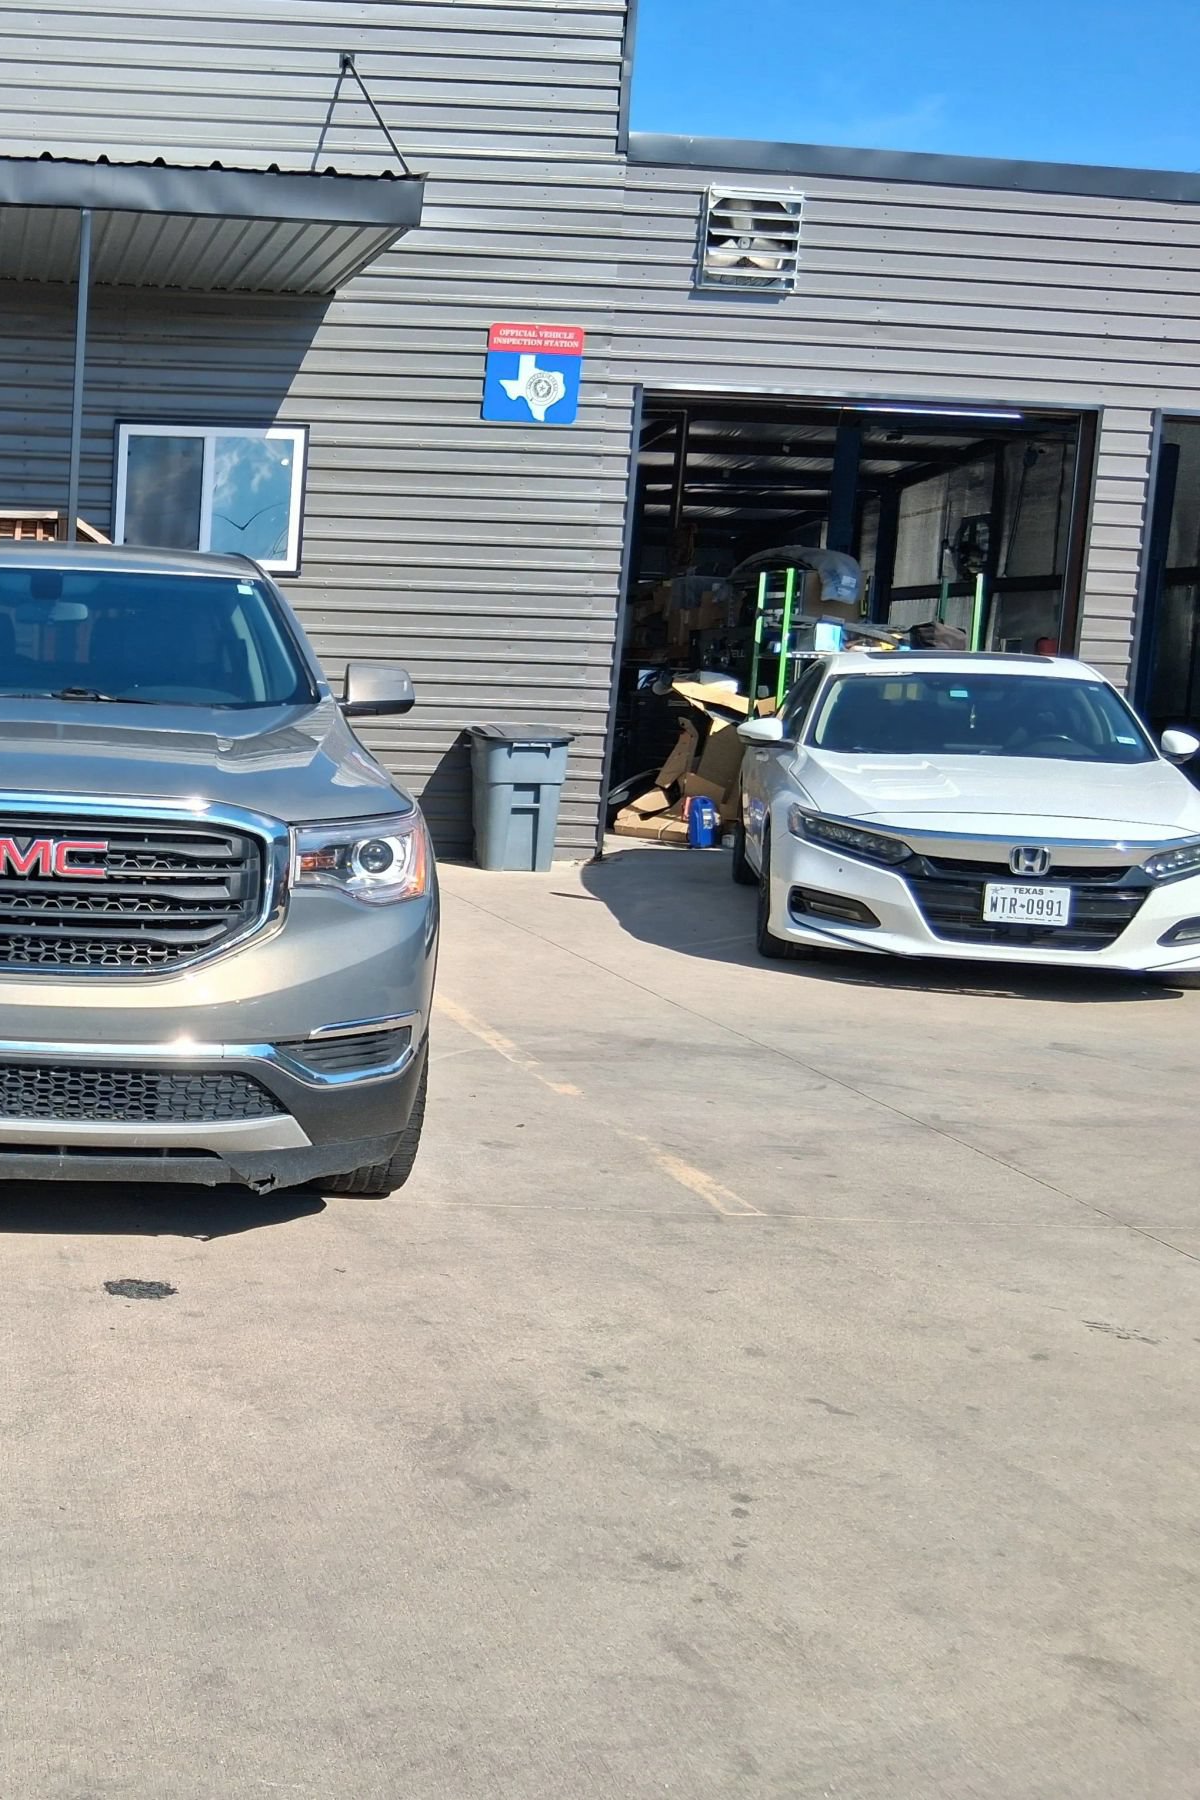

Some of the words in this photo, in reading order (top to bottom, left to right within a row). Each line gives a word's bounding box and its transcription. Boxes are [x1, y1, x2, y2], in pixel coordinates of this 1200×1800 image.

[499, 328, 538, 338] OFFICIAL
[539, 331, 574, 340] VEHICLE
[493, 337, 542, 347] INSPECTION
[543, 340, 579, 348] STATION
[1013, 887, 1045, 896] TEXAS
